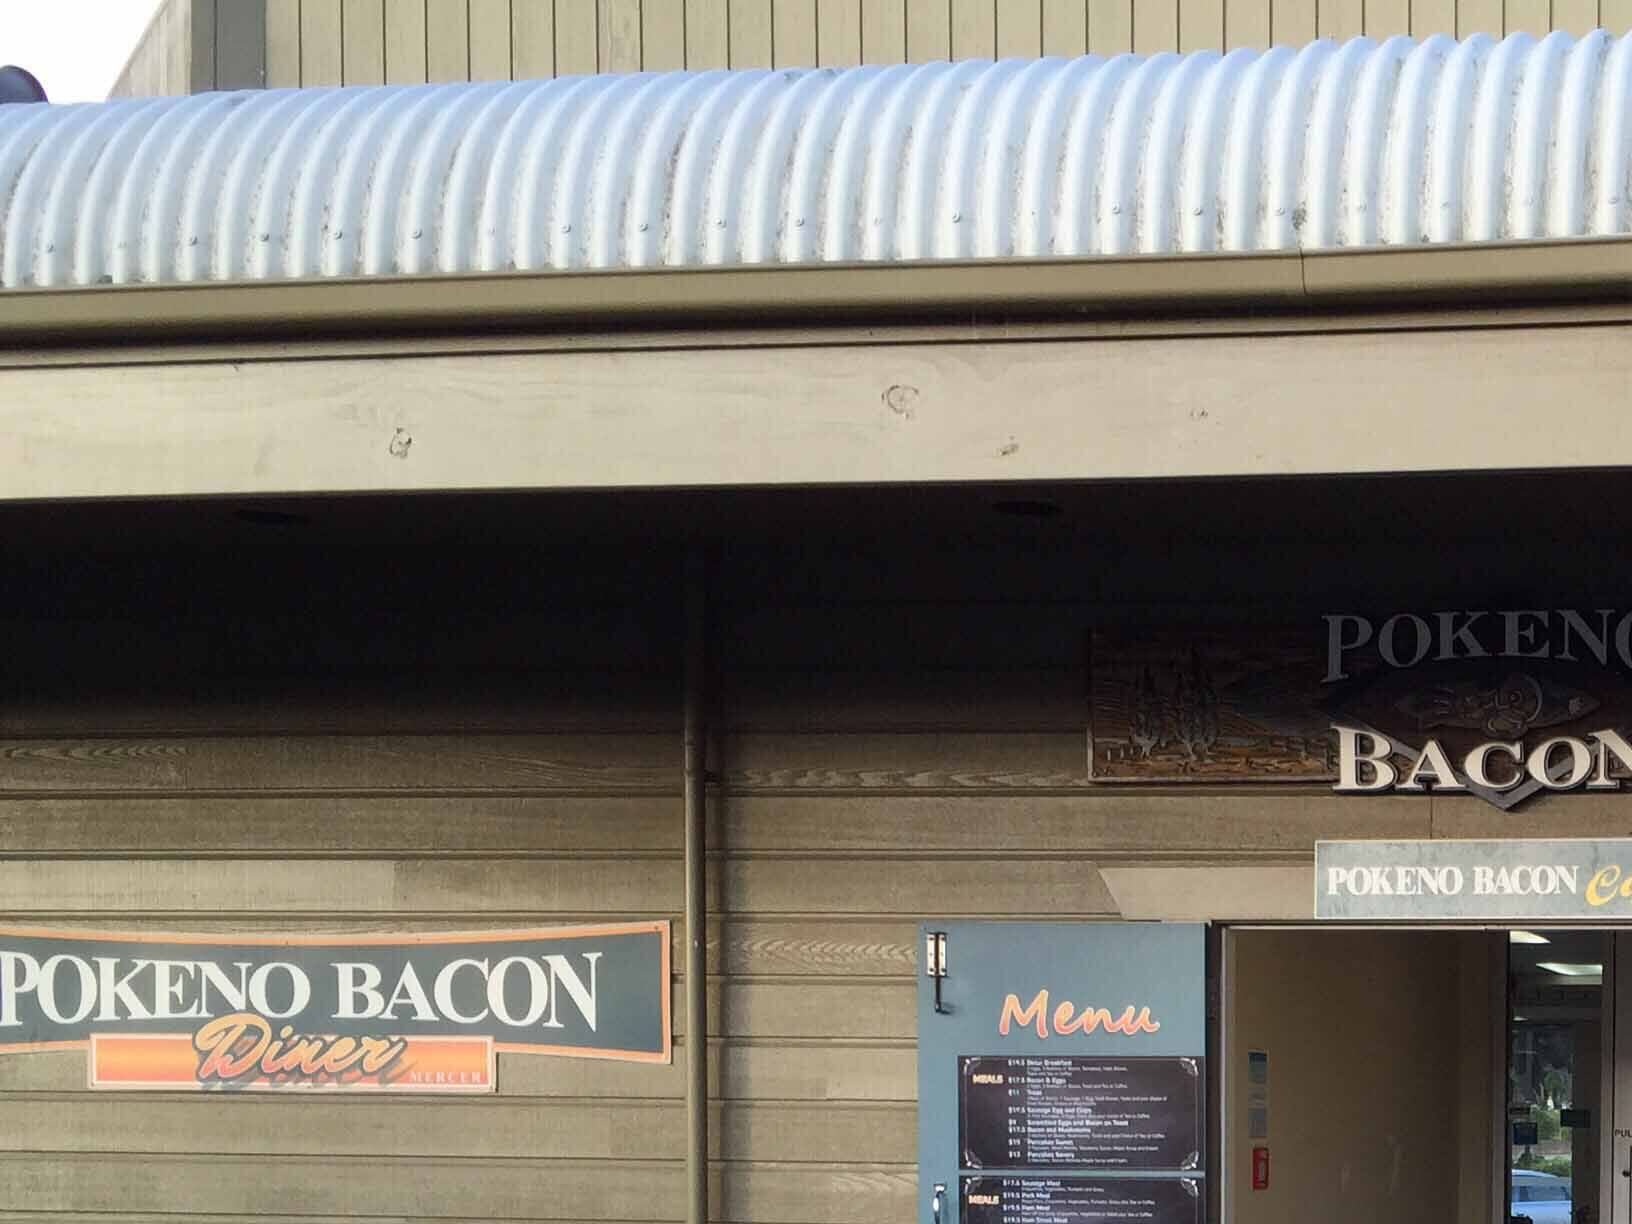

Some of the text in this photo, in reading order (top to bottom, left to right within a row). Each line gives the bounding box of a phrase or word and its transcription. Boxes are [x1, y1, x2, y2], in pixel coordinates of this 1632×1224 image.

[1327, 865, 1463, 896] POKENO
[1473, 865, 1578, 896] BACON
[0, 950, 602, 1033] POKENO BACON
[998, 989, 1160, 1038] Menu
[193, 1013, 405, 1079] Diner
